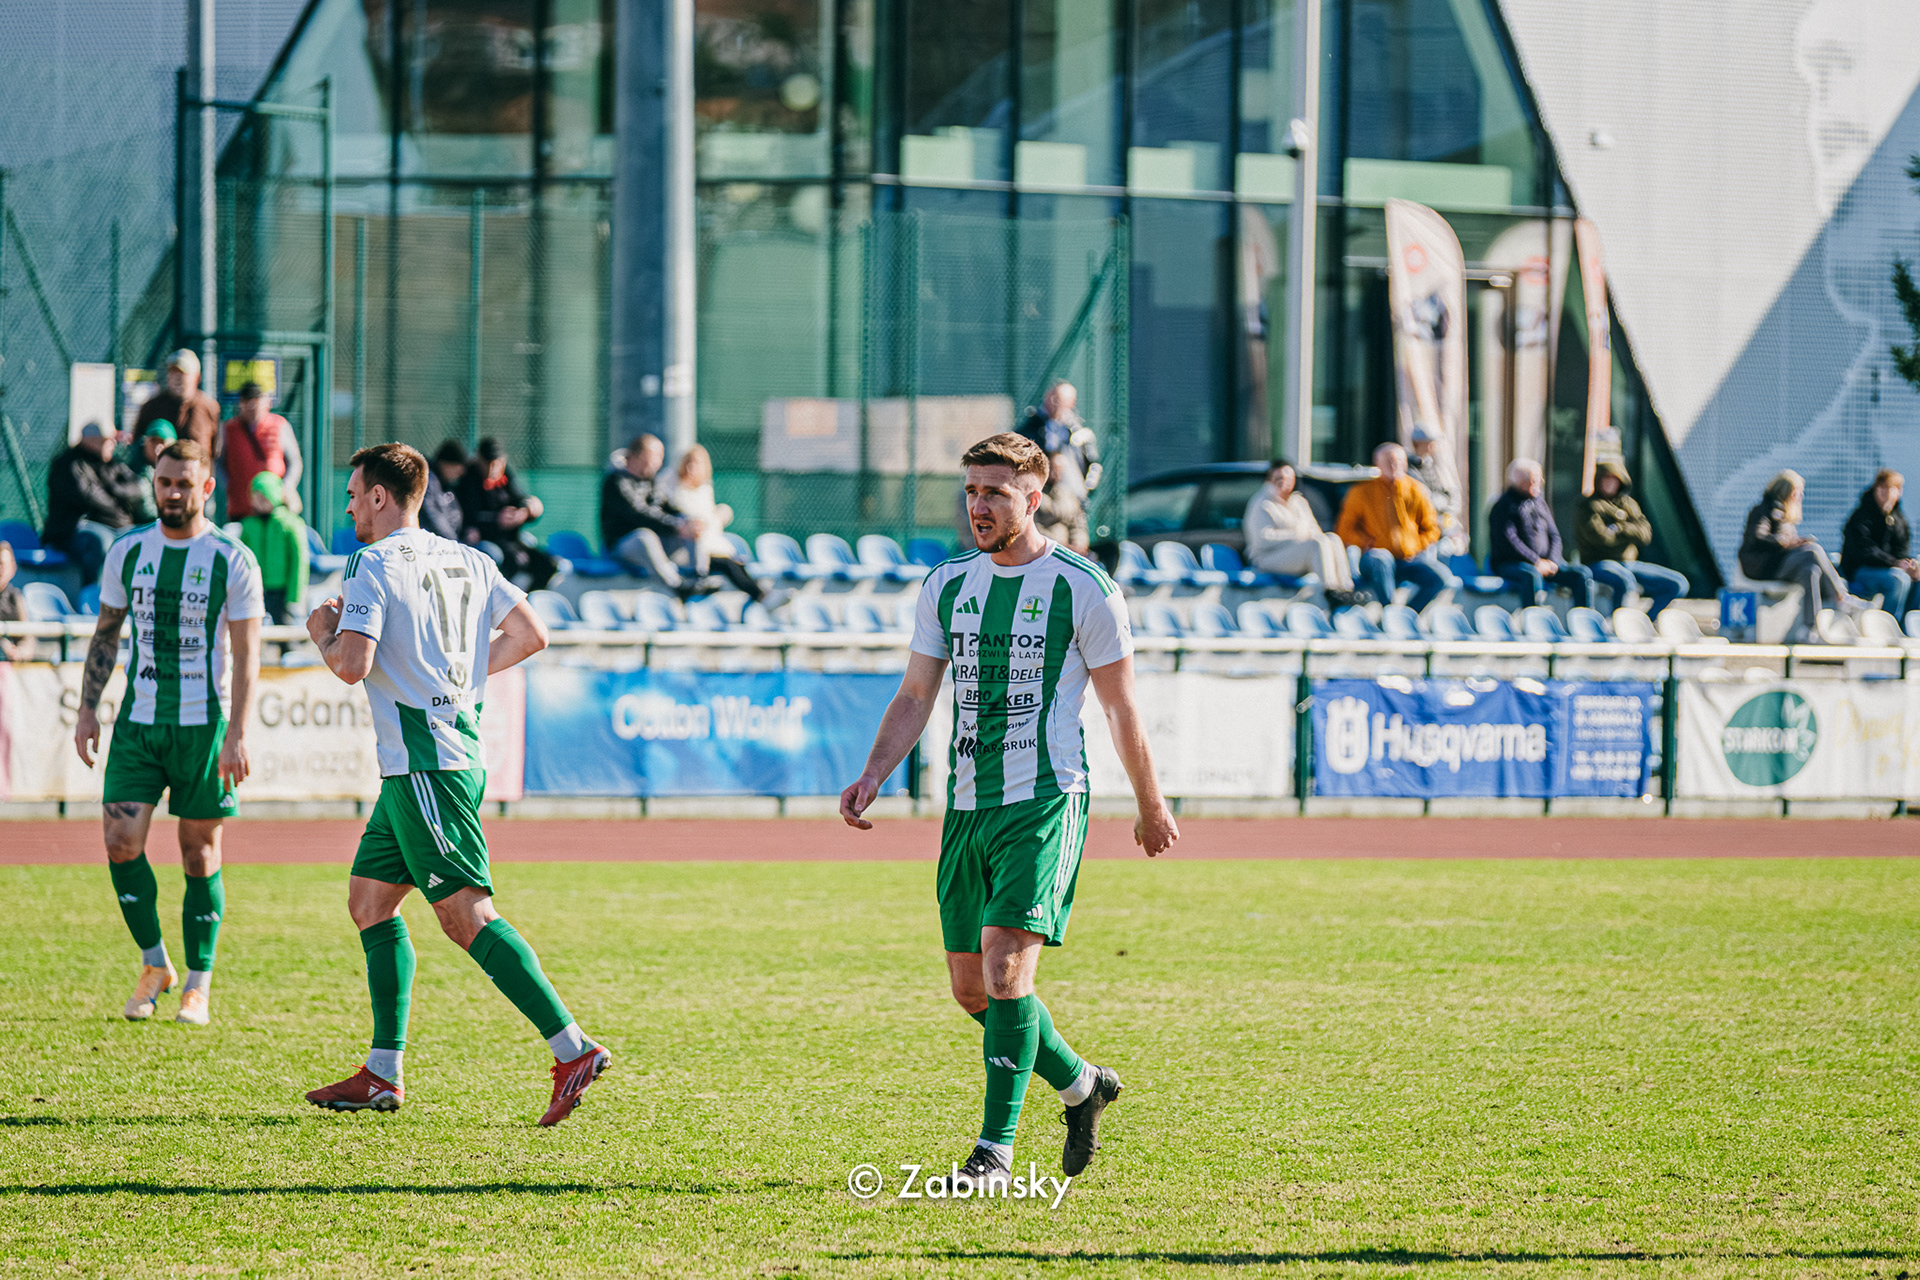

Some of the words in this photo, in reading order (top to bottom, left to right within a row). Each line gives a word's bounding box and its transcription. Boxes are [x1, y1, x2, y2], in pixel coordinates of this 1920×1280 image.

[968, 632, 1045, 648] PANTOR
[968, 649, 1000, 658] DRZWI
[1003, 650, 1016, 659] NA
[1018, 651, 1044, 659] LATA
[258, 687, 373, 728] Gdańs
[1371, 711, 1547, 773] Husqvarna
